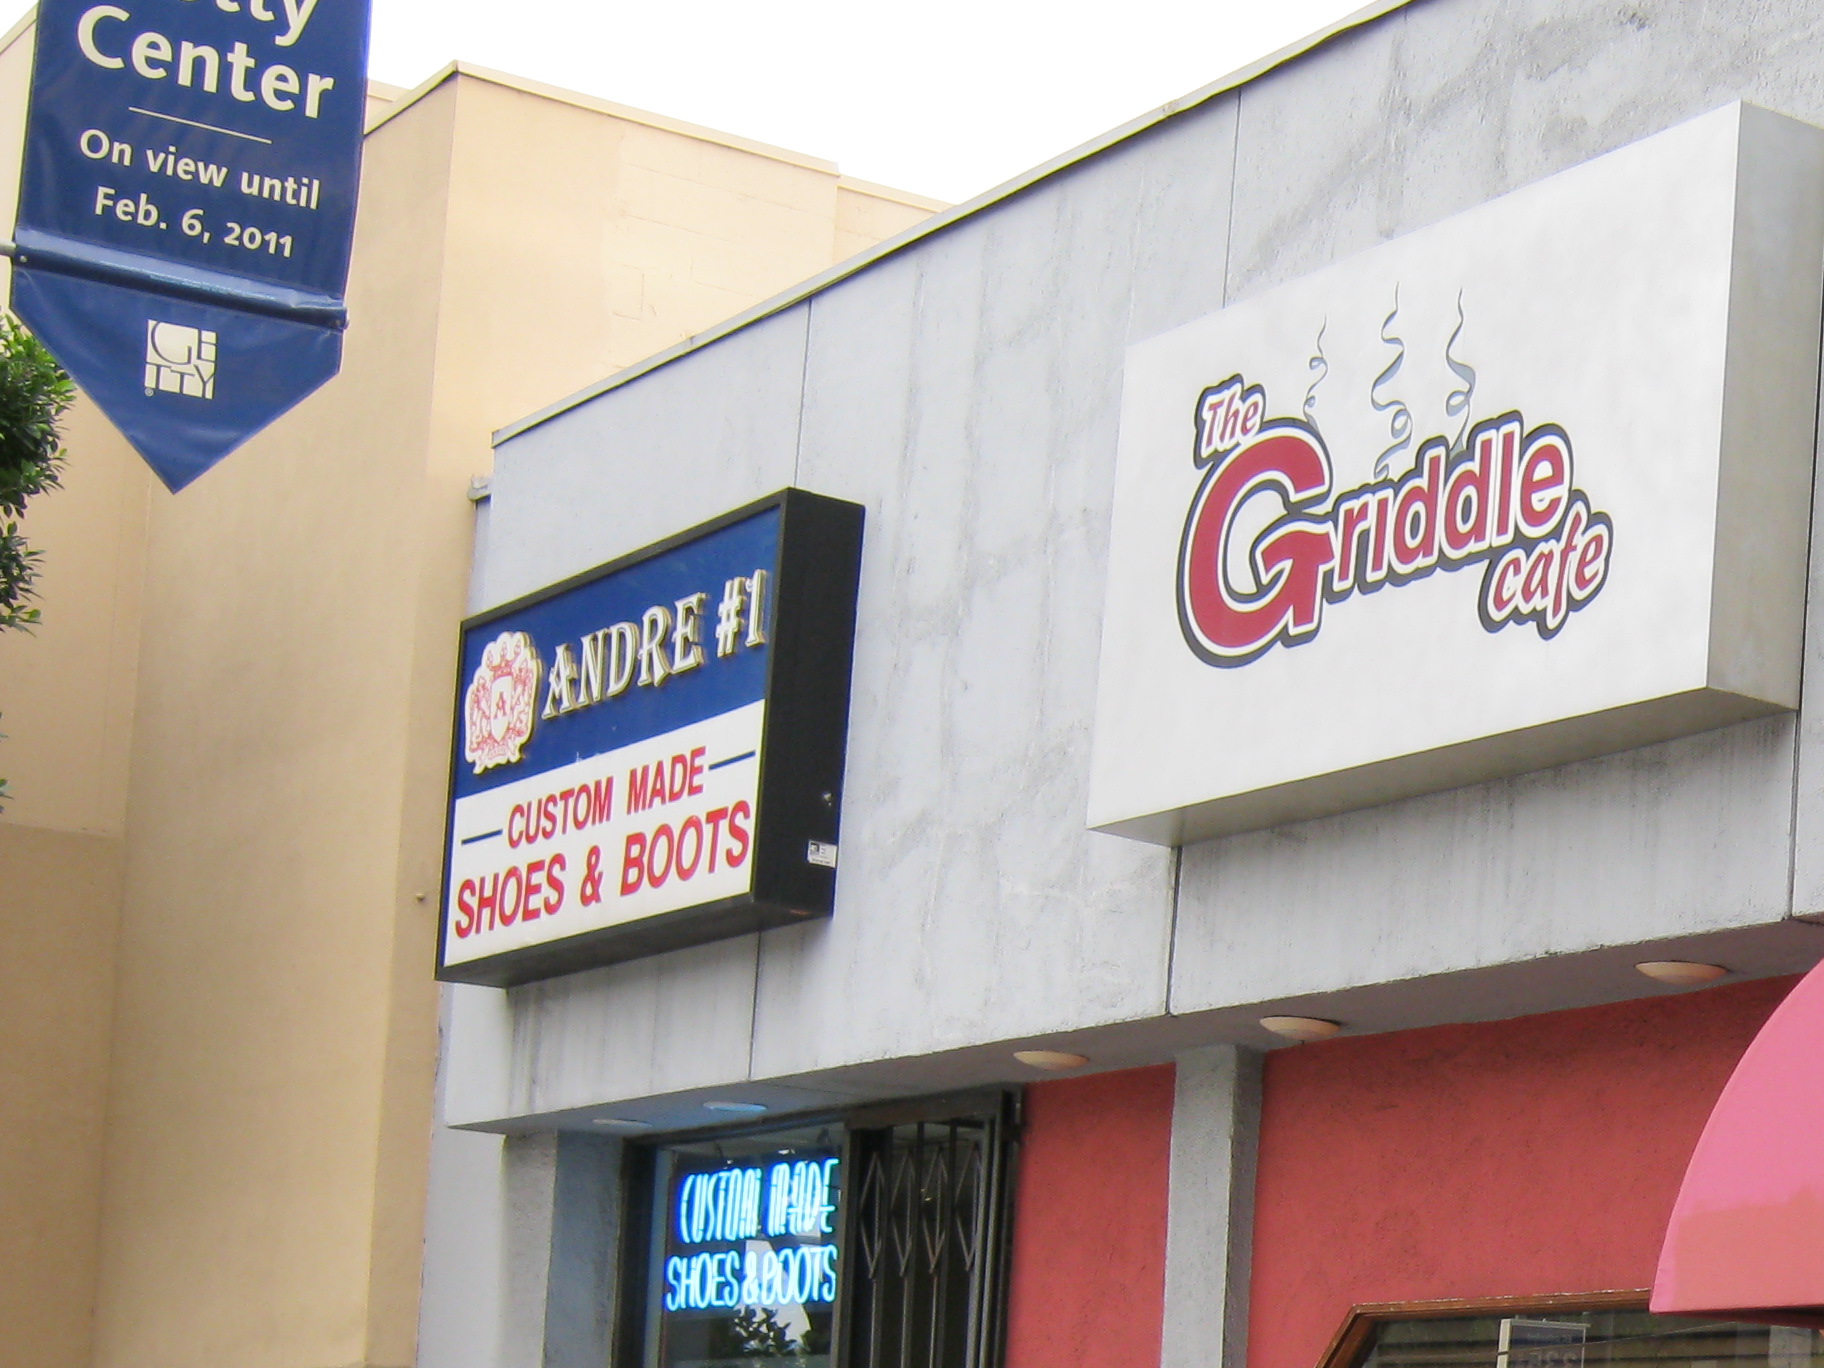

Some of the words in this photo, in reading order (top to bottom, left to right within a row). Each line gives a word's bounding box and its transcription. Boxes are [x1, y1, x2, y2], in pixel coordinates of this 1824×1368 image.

[77, 5, 335, 119] Center
[80, 129, 132, 166] On
[145, 145, 228, 188] view
[240, 170, 321, 210] until
[95, 186, 168, 230] Feb.
[182, 208, 211, 244] 6,
[224, 222, 293, 258] 2011
[1201, 383, 1261, 457] The
[1183, 422, 1570, 656] Griddle
[1487, 502, 1609, 631] cafe
[542, 592, 707, 720] ANDRE
[716, 569, 767, 658] #1
[508, 776, 614, 849] CUSTOM
[626, 746, 707, 816] MADE
[455, 852, 567, 938] SHOES
[580, 845, 603, 906] &
[620, 800, 751, 896] BOOTS
[680, 1168, 762, 1243] CUSTOM
[767, 1159, 840, 1236] MADE
[667, 1251, 740, 1311] SHOES
[742, 1251, 759, 1304] &
[762, 1244, 838, 1305] BOOTS
